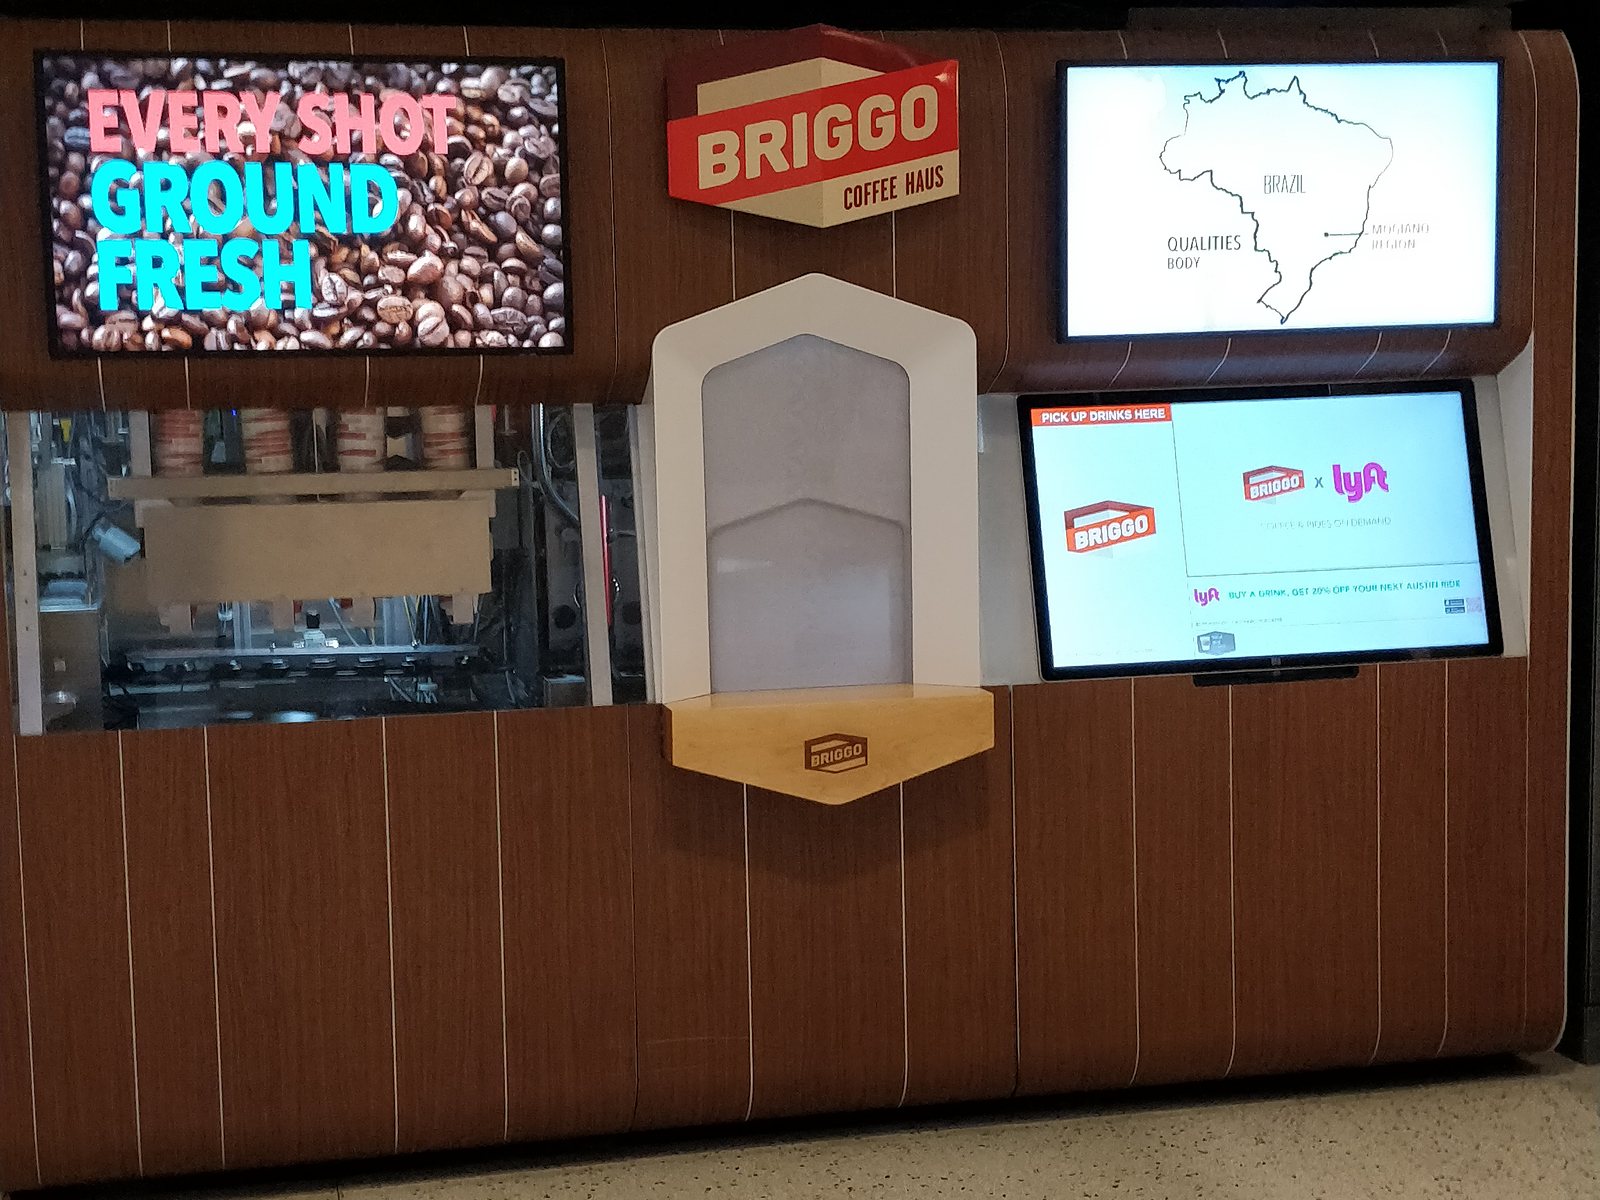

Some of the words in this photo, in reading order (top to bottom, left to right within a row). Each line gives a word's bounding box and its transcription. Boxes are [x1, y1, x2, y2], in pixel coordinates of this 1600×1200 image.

[87, 89, 281, 154] EVERY
[297, 92, 457, 155] SHOT
[697, 84, 938, 190] BRIGGO
[843, 175, 898, 210] COFFEE
[905, 165, 944, 195] HAUS
[1263, 174, 1306, 194] BRAZIL
[91, 159, 400, 236] GROUND
[1167, 235, 1242, 252] QUALITIES
[97, 239, 313, 311] FRESH
[1167, 257, 1200, 270] BODY
[1041, 412, 1069, 423] PICK
[1072, 411, 1087, 422] UP
[1089, 409, 1132, 421] DRINKS
[1134, 408, 1166, 419] HERE
[1249, 474, 1300, 499] BRIGGO
[1333, 462, 1390, 503] lyft
[1074, 513, 1150, 551] BRIGGO
[1351, 516, 1392, 527] DEMAND
[1194, 587, 1220, 606] lyft
[1229, 591, 1246, 599] BUY
[1292, 588, 1309, 596] GET
[1312, 587, 1331, 595] 20%
[1333, 585, 1350, 594] OFF
[1353, 584, 1377, 593] YOUR
[1380, 583, 1403, 592] NEXT
[1406, 581, 1438, 590] AUSTIN
[1441, 579, 1461, 588] RIDE
[811, 743, 862, 767] BRIGGO
